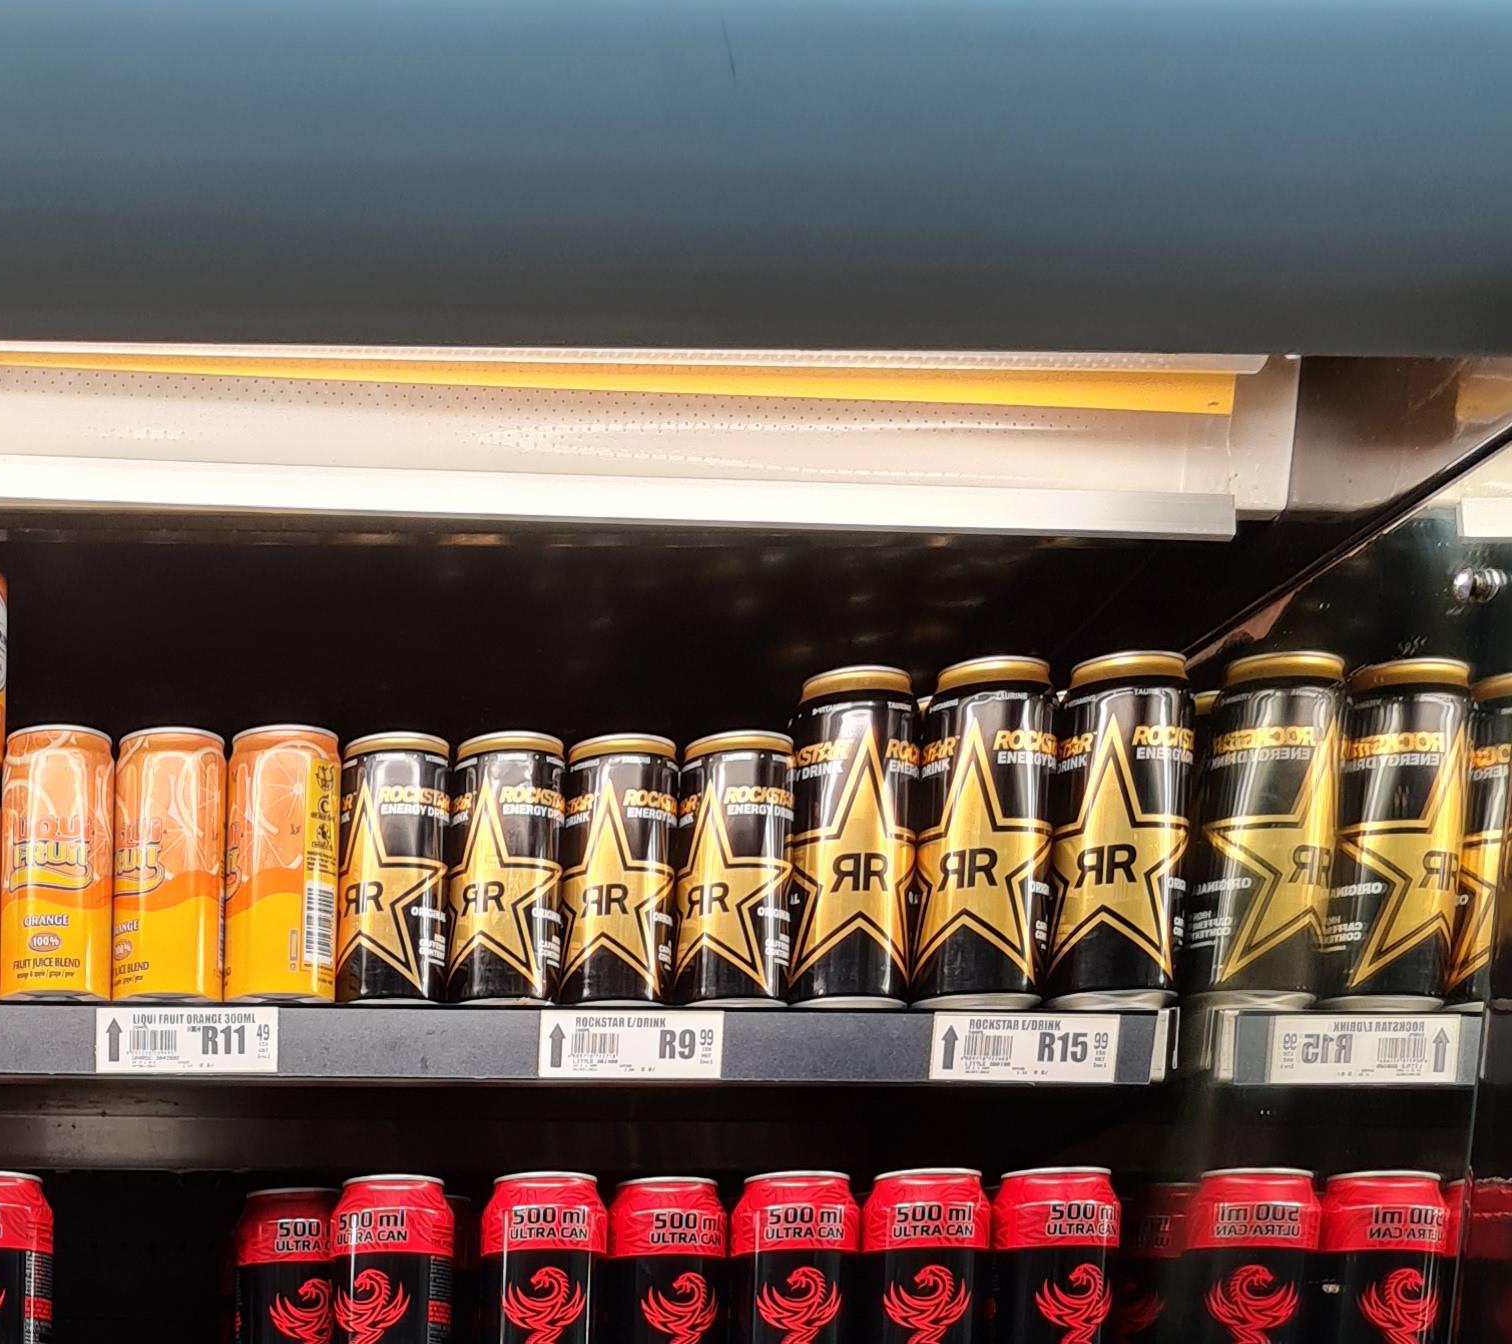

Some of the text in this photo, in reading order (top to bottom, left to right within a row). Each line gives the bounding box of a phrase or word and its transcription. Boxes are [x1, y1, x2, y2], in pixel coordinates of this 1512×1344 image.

[24, 913, 69, 927] ORANGE
[31, 936, 59, 947] 100%
[133, 1014, 256, 1025] LIQUI FRUIT ORANGE 300ML
[969, 1020, 1061, 1031] ROCKSTAR E/DRINK
[201, 1025, 270, 1055] R11 49
[1037, 1032, 1108, 1064] R15 99
[512, 1208, 557, 1226] 500
[509, 1226, 588, 1240] ULTRA CAN
